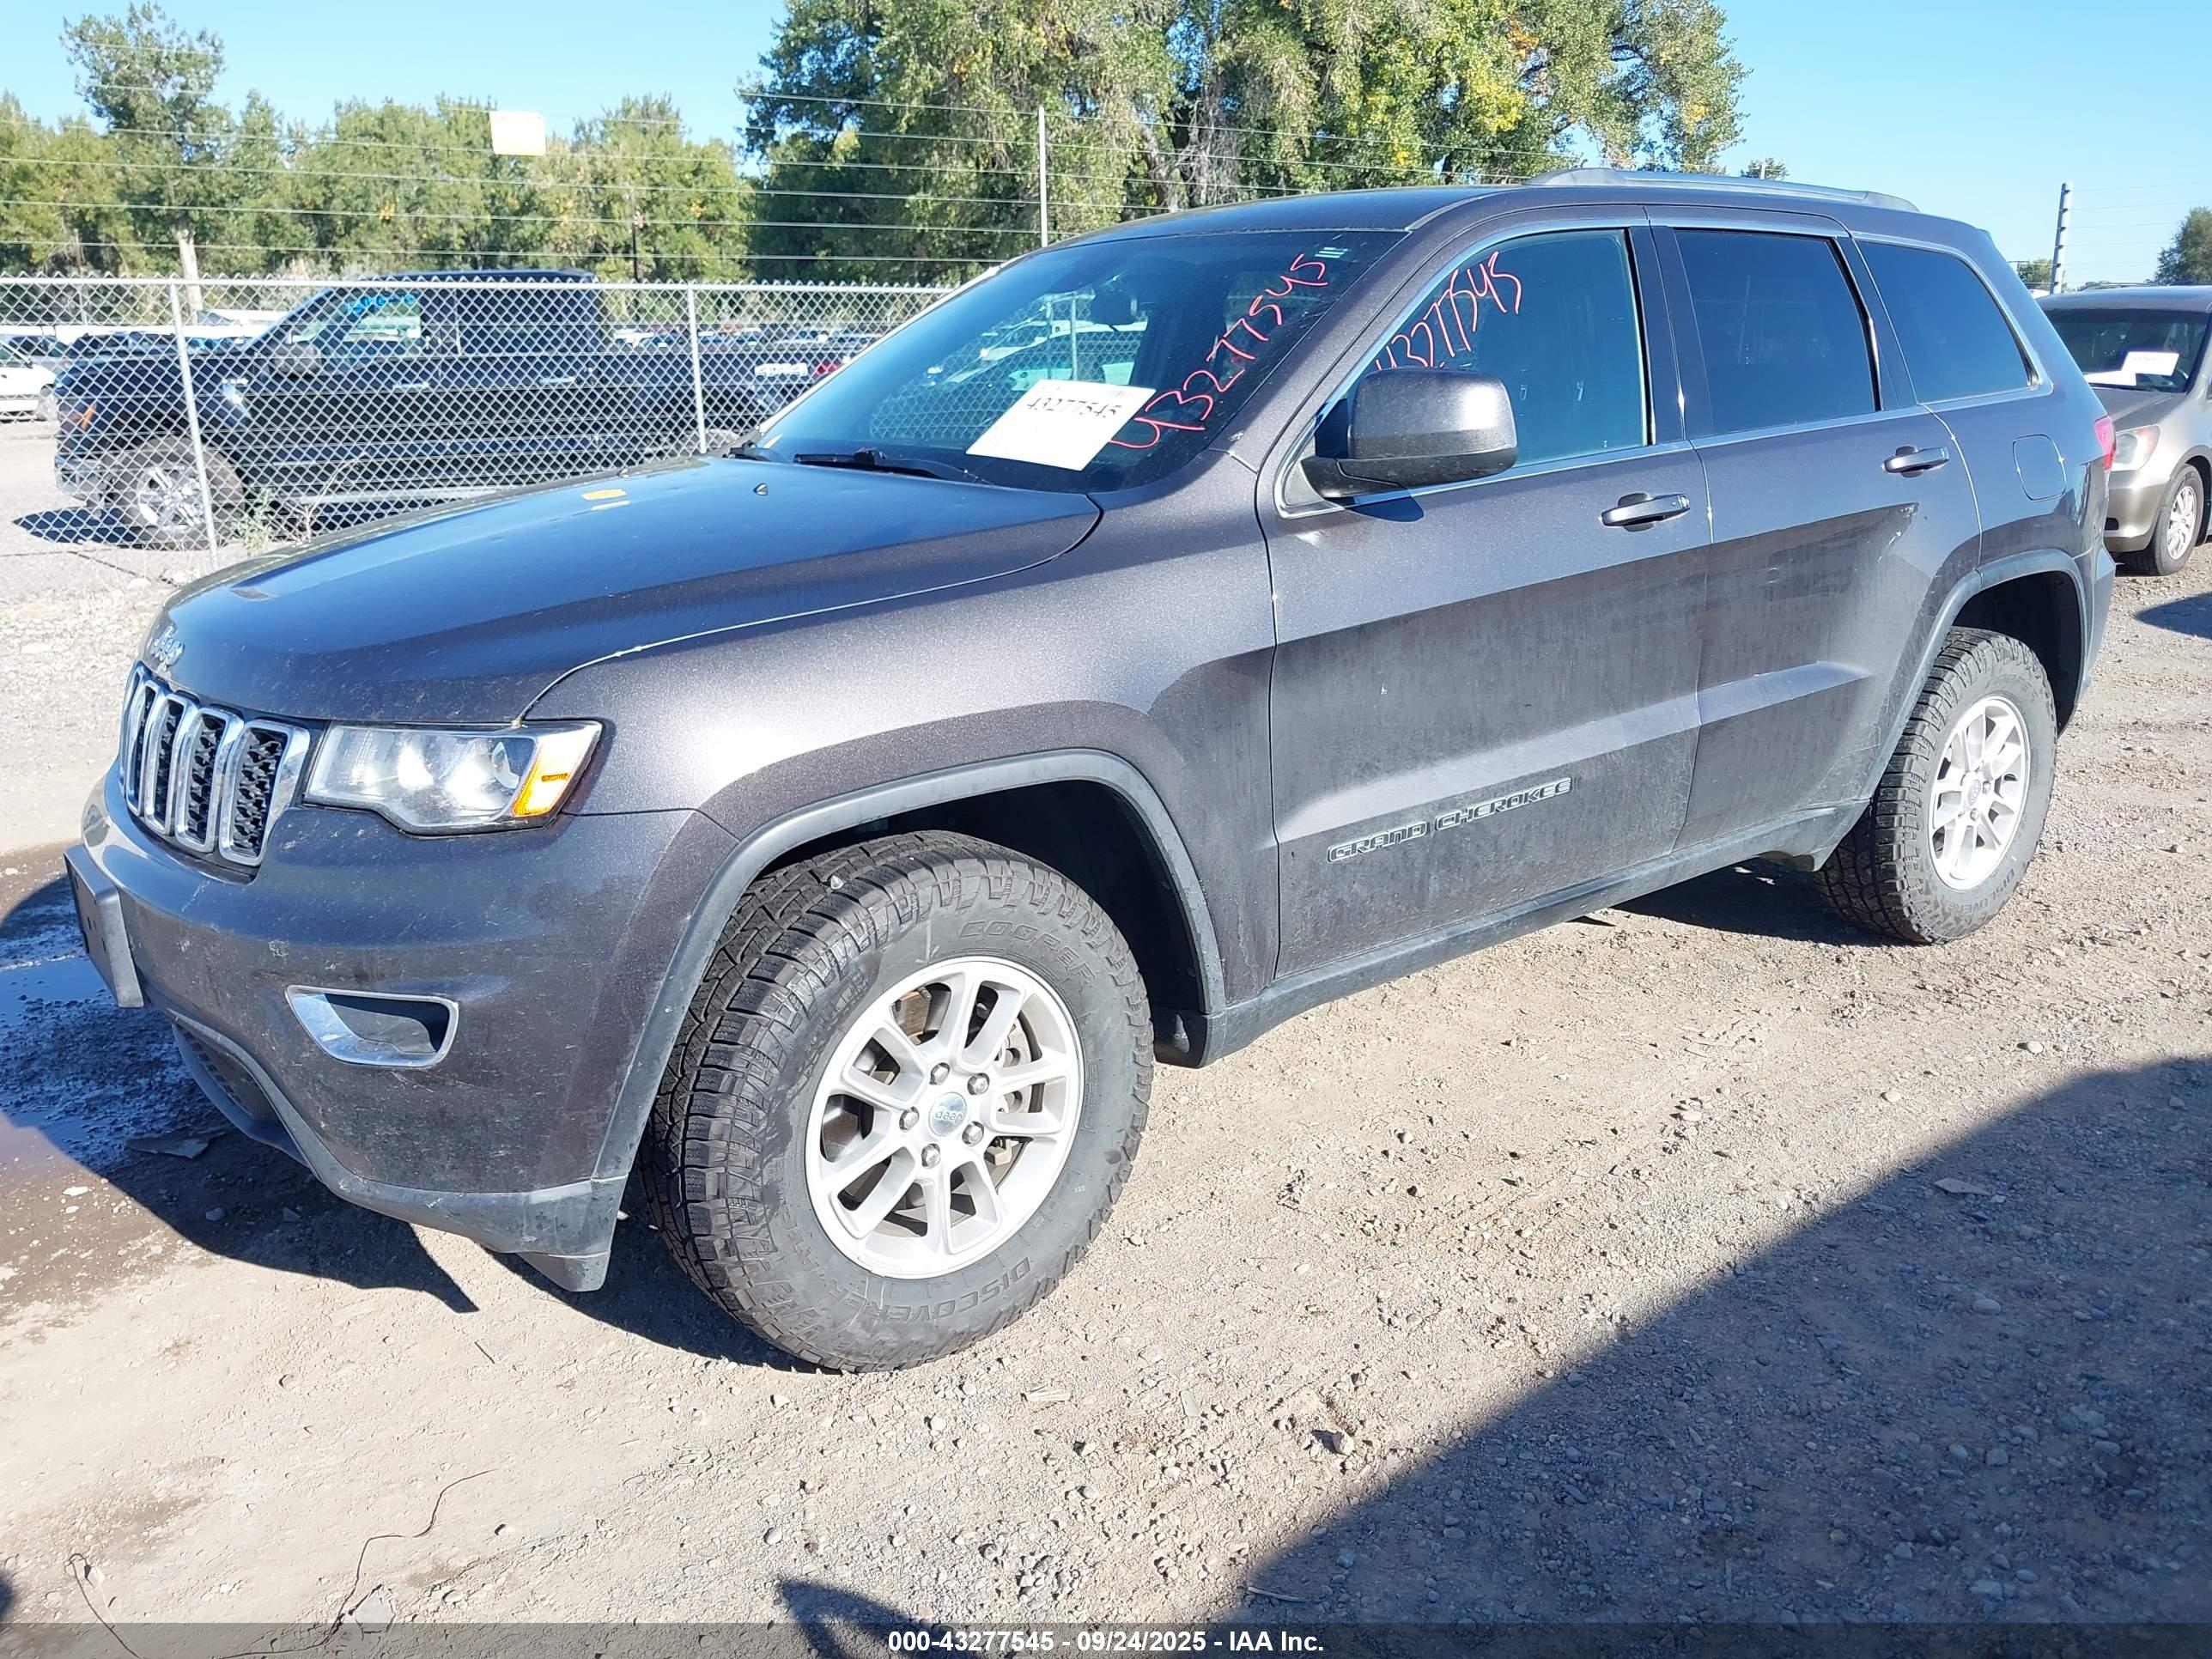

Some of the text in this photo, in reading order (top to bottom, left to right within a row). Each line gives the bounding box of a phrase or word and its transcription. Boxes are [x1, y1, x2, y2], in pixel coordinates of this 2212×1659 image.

[1107, 252, 1328, 449] 43277545
[1328, 777, 1573, 863] GRAND CHEROKEE
[958, 921, 1096, 979] COOPER
